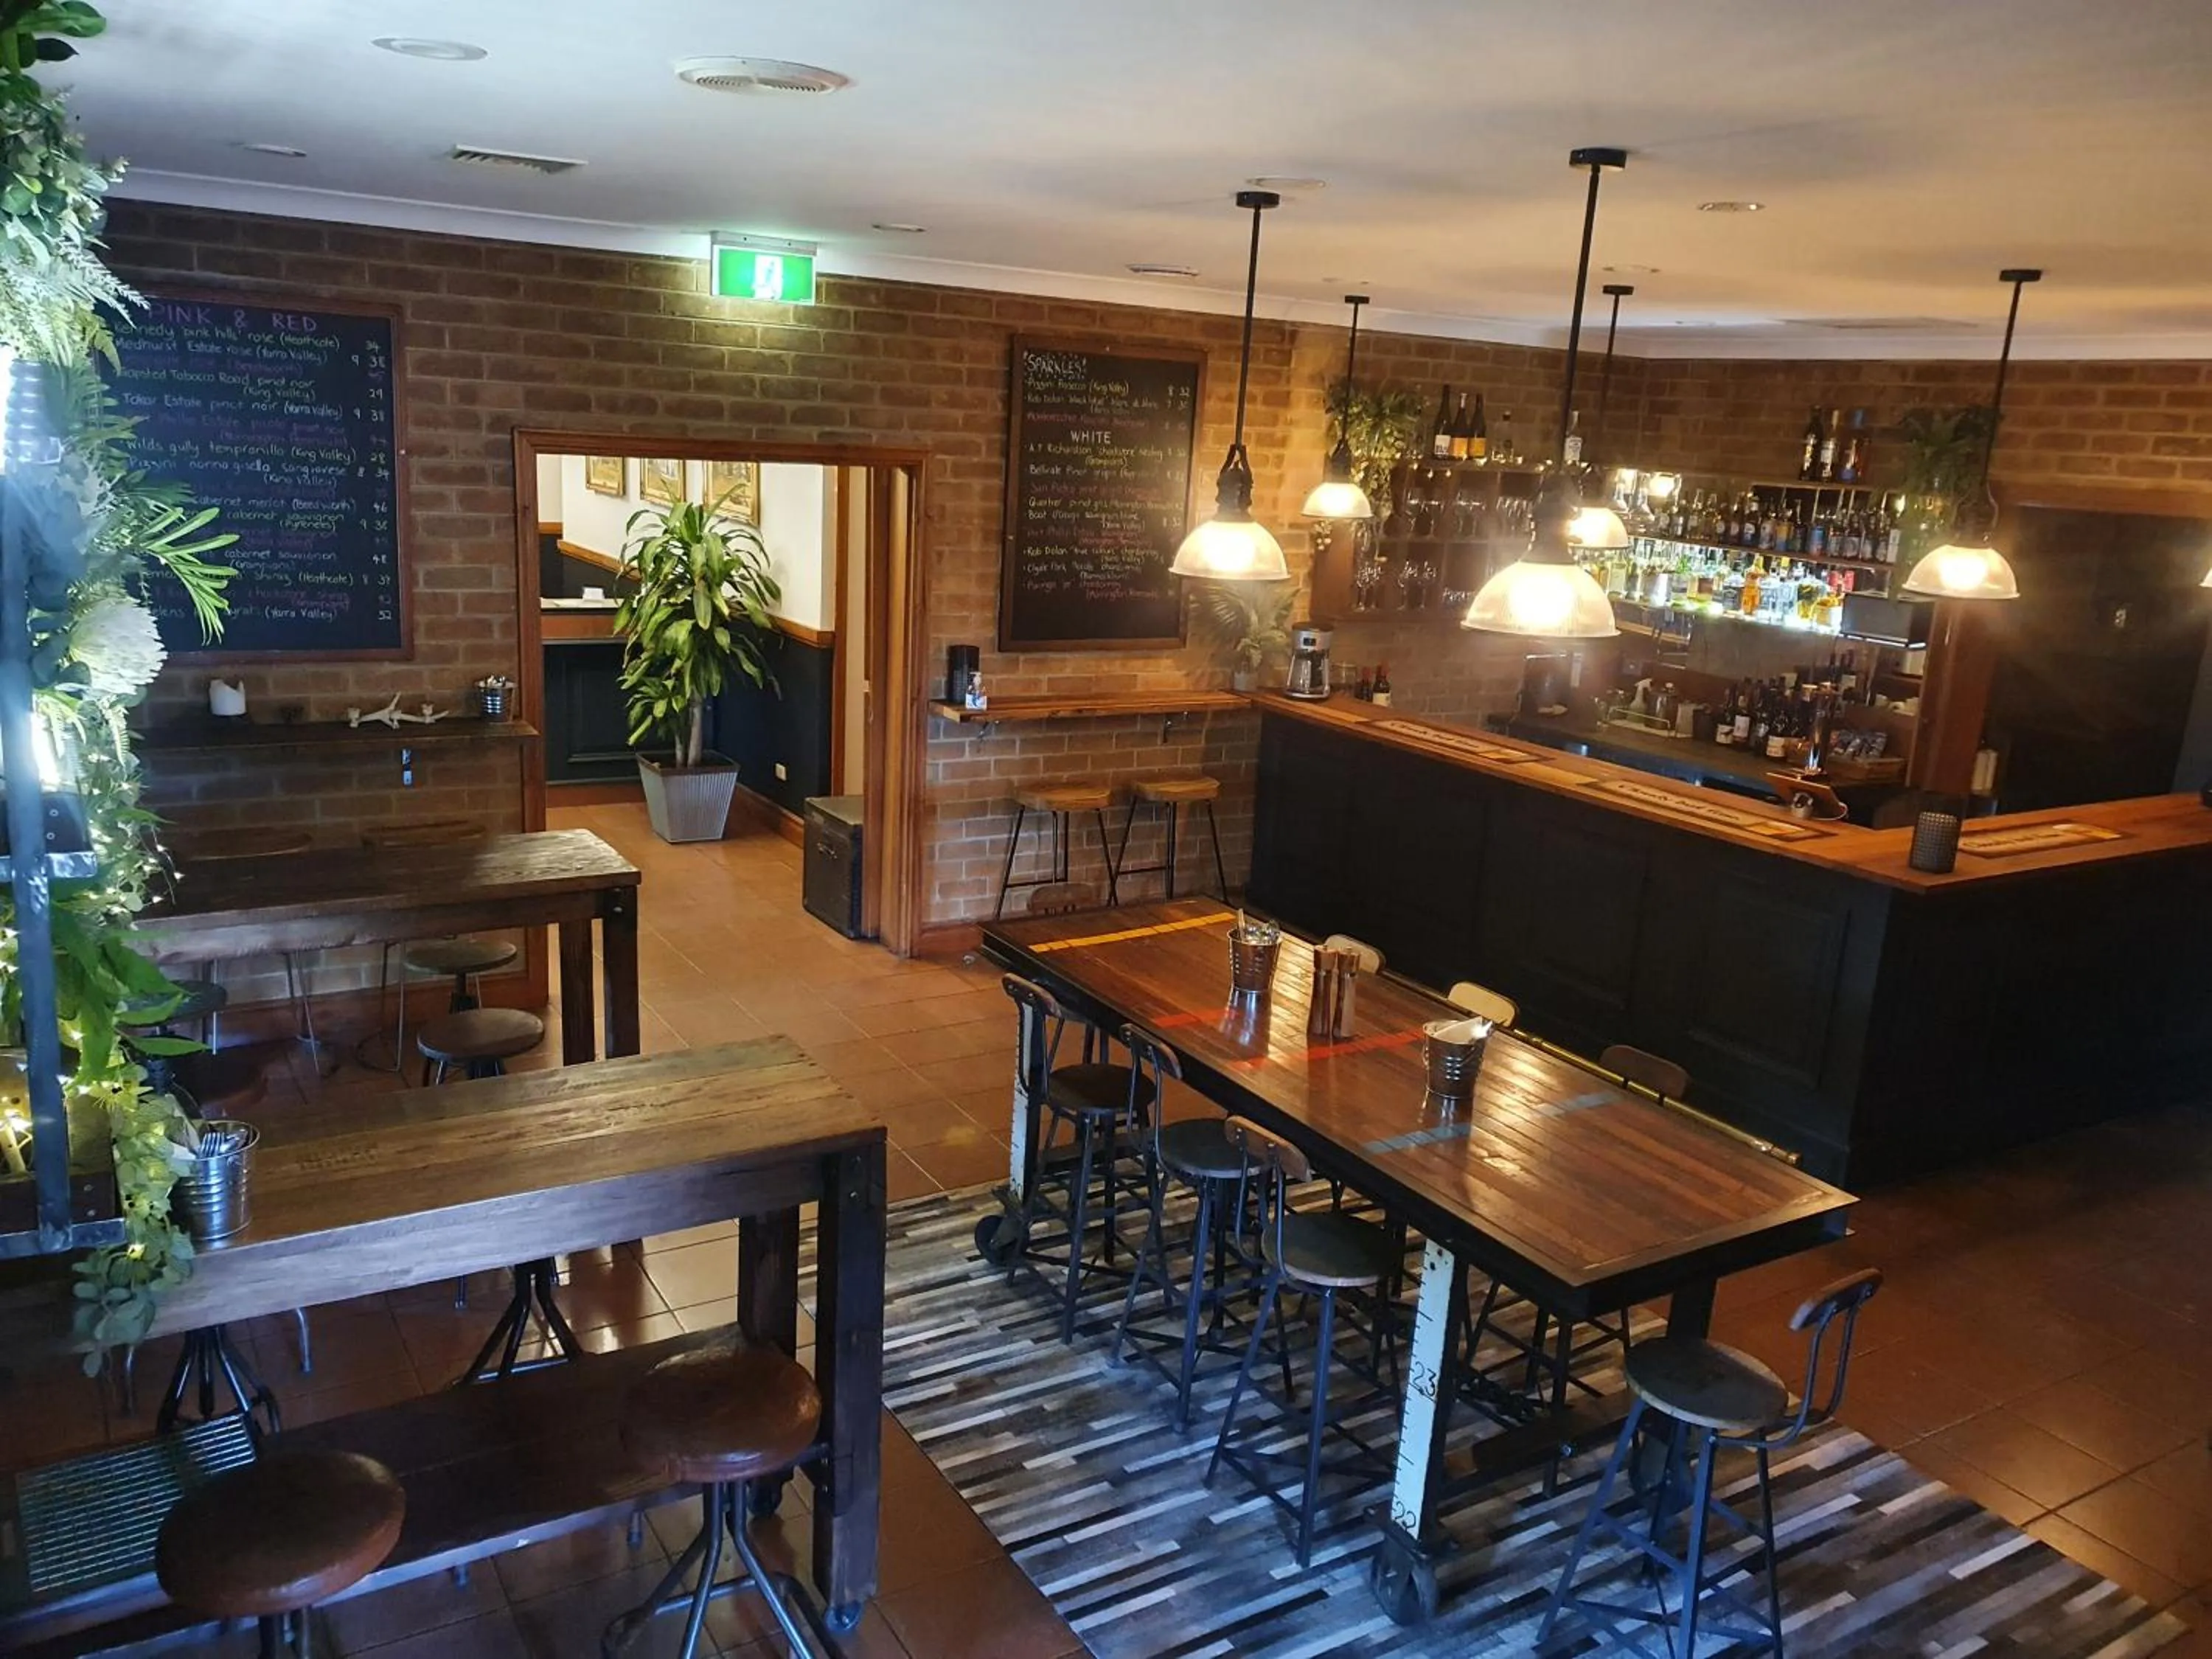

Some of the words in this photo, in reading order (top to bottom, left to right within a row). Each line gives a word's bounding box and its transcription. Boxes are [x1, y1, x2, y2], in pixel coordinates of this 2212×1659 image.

[148, 303, 212, 324] PINK
[234, 309, 248, 328] &
[271, 313, 317, 331] RED
[187, 340, 222, 352] Estate
[351, 354, 360, 366] 9
[219, 372, 250, 386] Road
[164, 394, 203, 408] Estate
[1070, 430, 1112, 444] WHITE
[170, 439, 200, 459] gully
[319, 448, 357, 466] Valley)
[1411, 1360, 1436, 1397] 23
